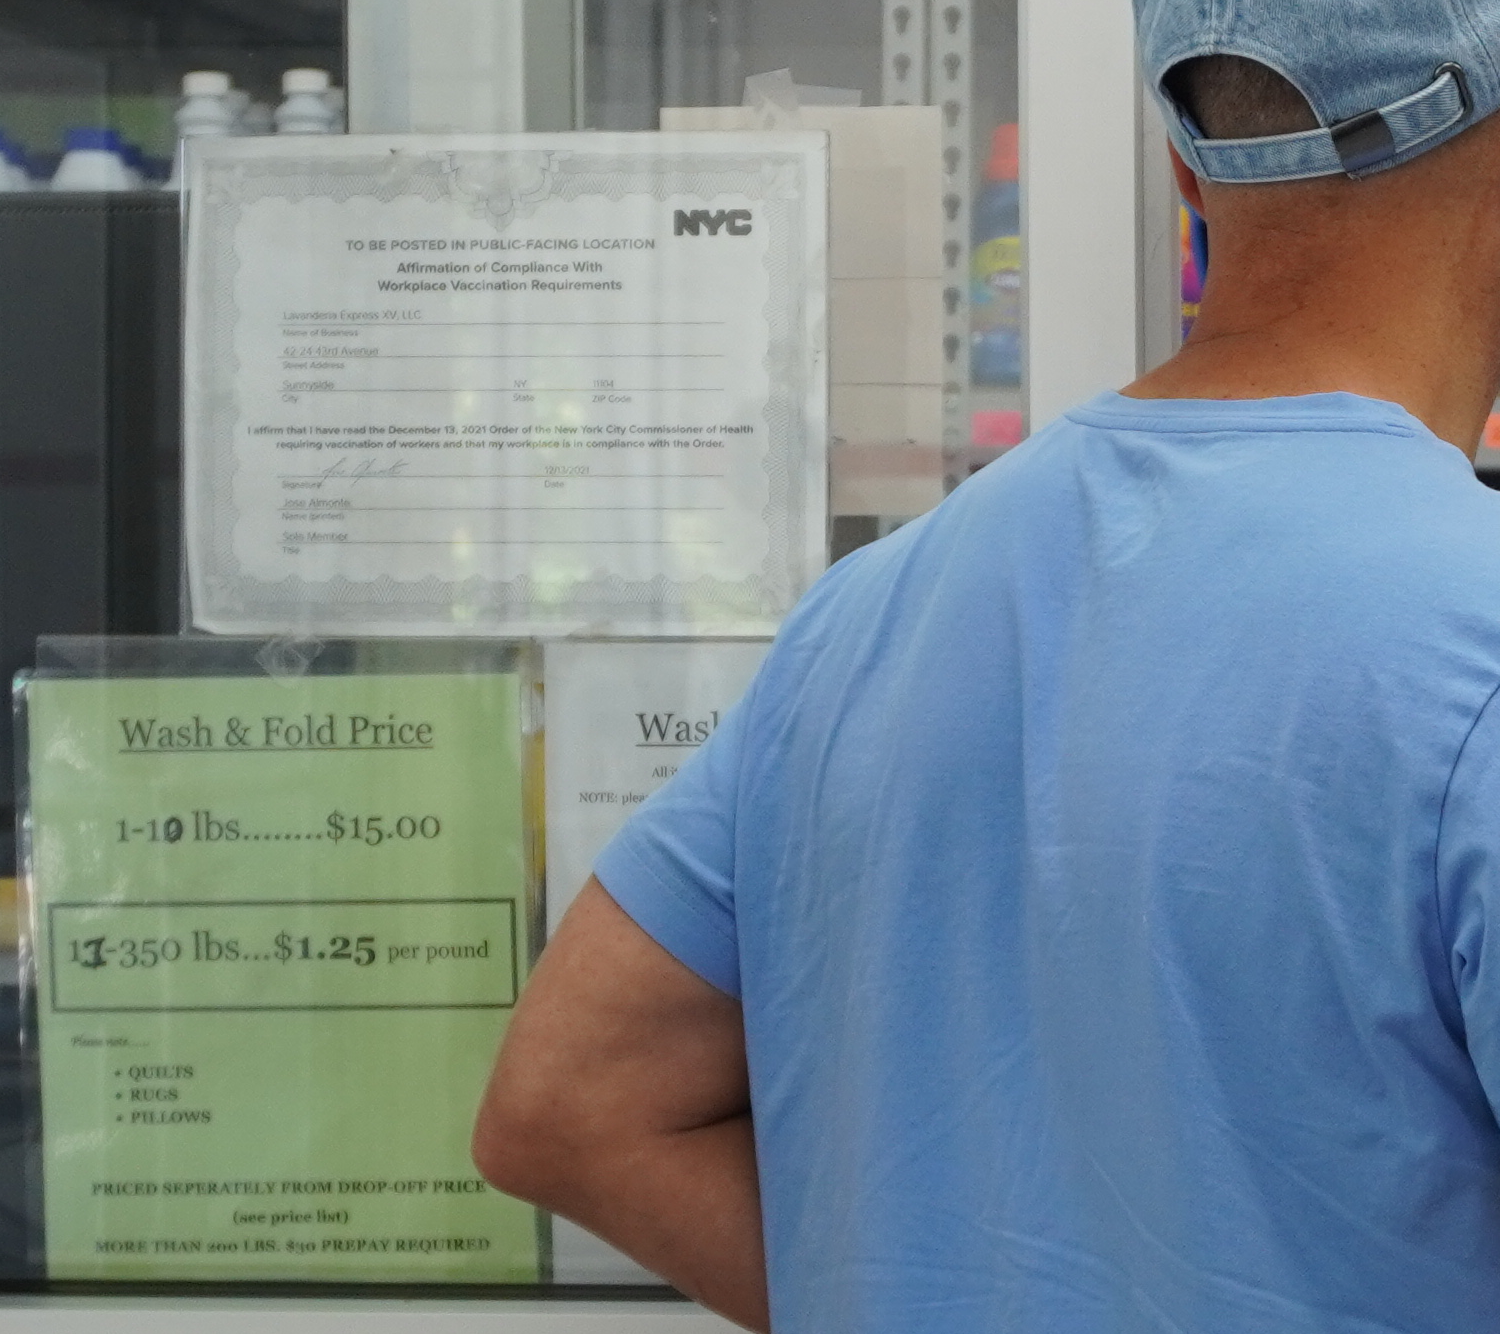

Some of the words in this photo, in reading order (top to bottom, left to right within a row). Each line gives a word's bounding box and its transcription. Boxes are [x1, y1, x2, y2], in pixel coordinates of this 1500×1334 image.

[673, 209, 753, 237] NYC
[345, 238, 366, 253] TO
[367, 238, 388, 253] BE
[389, 238, 449, 252] POSTED
[449, 239, 468, 251] IN
[468, 238, 580, 252] PUBLIC-FACING
[582, 237, 658, 251] LOCATION
[396, 261, 472, 275] Affirmation
[473, 261, 489, 274] of
[489, 260, 570, 276] Compliance
[572, 260, 604, 274] With
[376, 279, 448, 294] Workplace
[449, 278, 529, 293] Vaccination
[530, 278, 623, 293] Requirements
[118, 715, 214, 749] Wash
[224, 715, 252, 747] &
[262, 712, 338, 747] Fold
[348, 712, 434, 746] Price
[579, 792, 618, 804] NOTE:
[387, 945, 420, 964] per
[426, 939, 490, 964] pound
[127, 1064, 195, 1082] QUILTS
[129, 1086, 180, 1103] RUGS
[130, 1109, 213, 1126] PILLOWS
[91, 1181, 159, 1197] PRICED
[161, 1180, 277, 1196] SEPERATELY
[280, 1180, 334, 1195] FROM
[337, 1179, 429, 1195] DROP-OFF
[432, 1178, 487, 1195] PRICE
[232, 1210, 268, 1226] (see
[269, 1209, 314, 1228] price
[95, 1239, 148, 1254] MORE
[153, 1238, 204, 1253] THAN
[320, 1237, 392, 1253] PREPAY
[394, 1236, 492, 1255] REQUIRED
